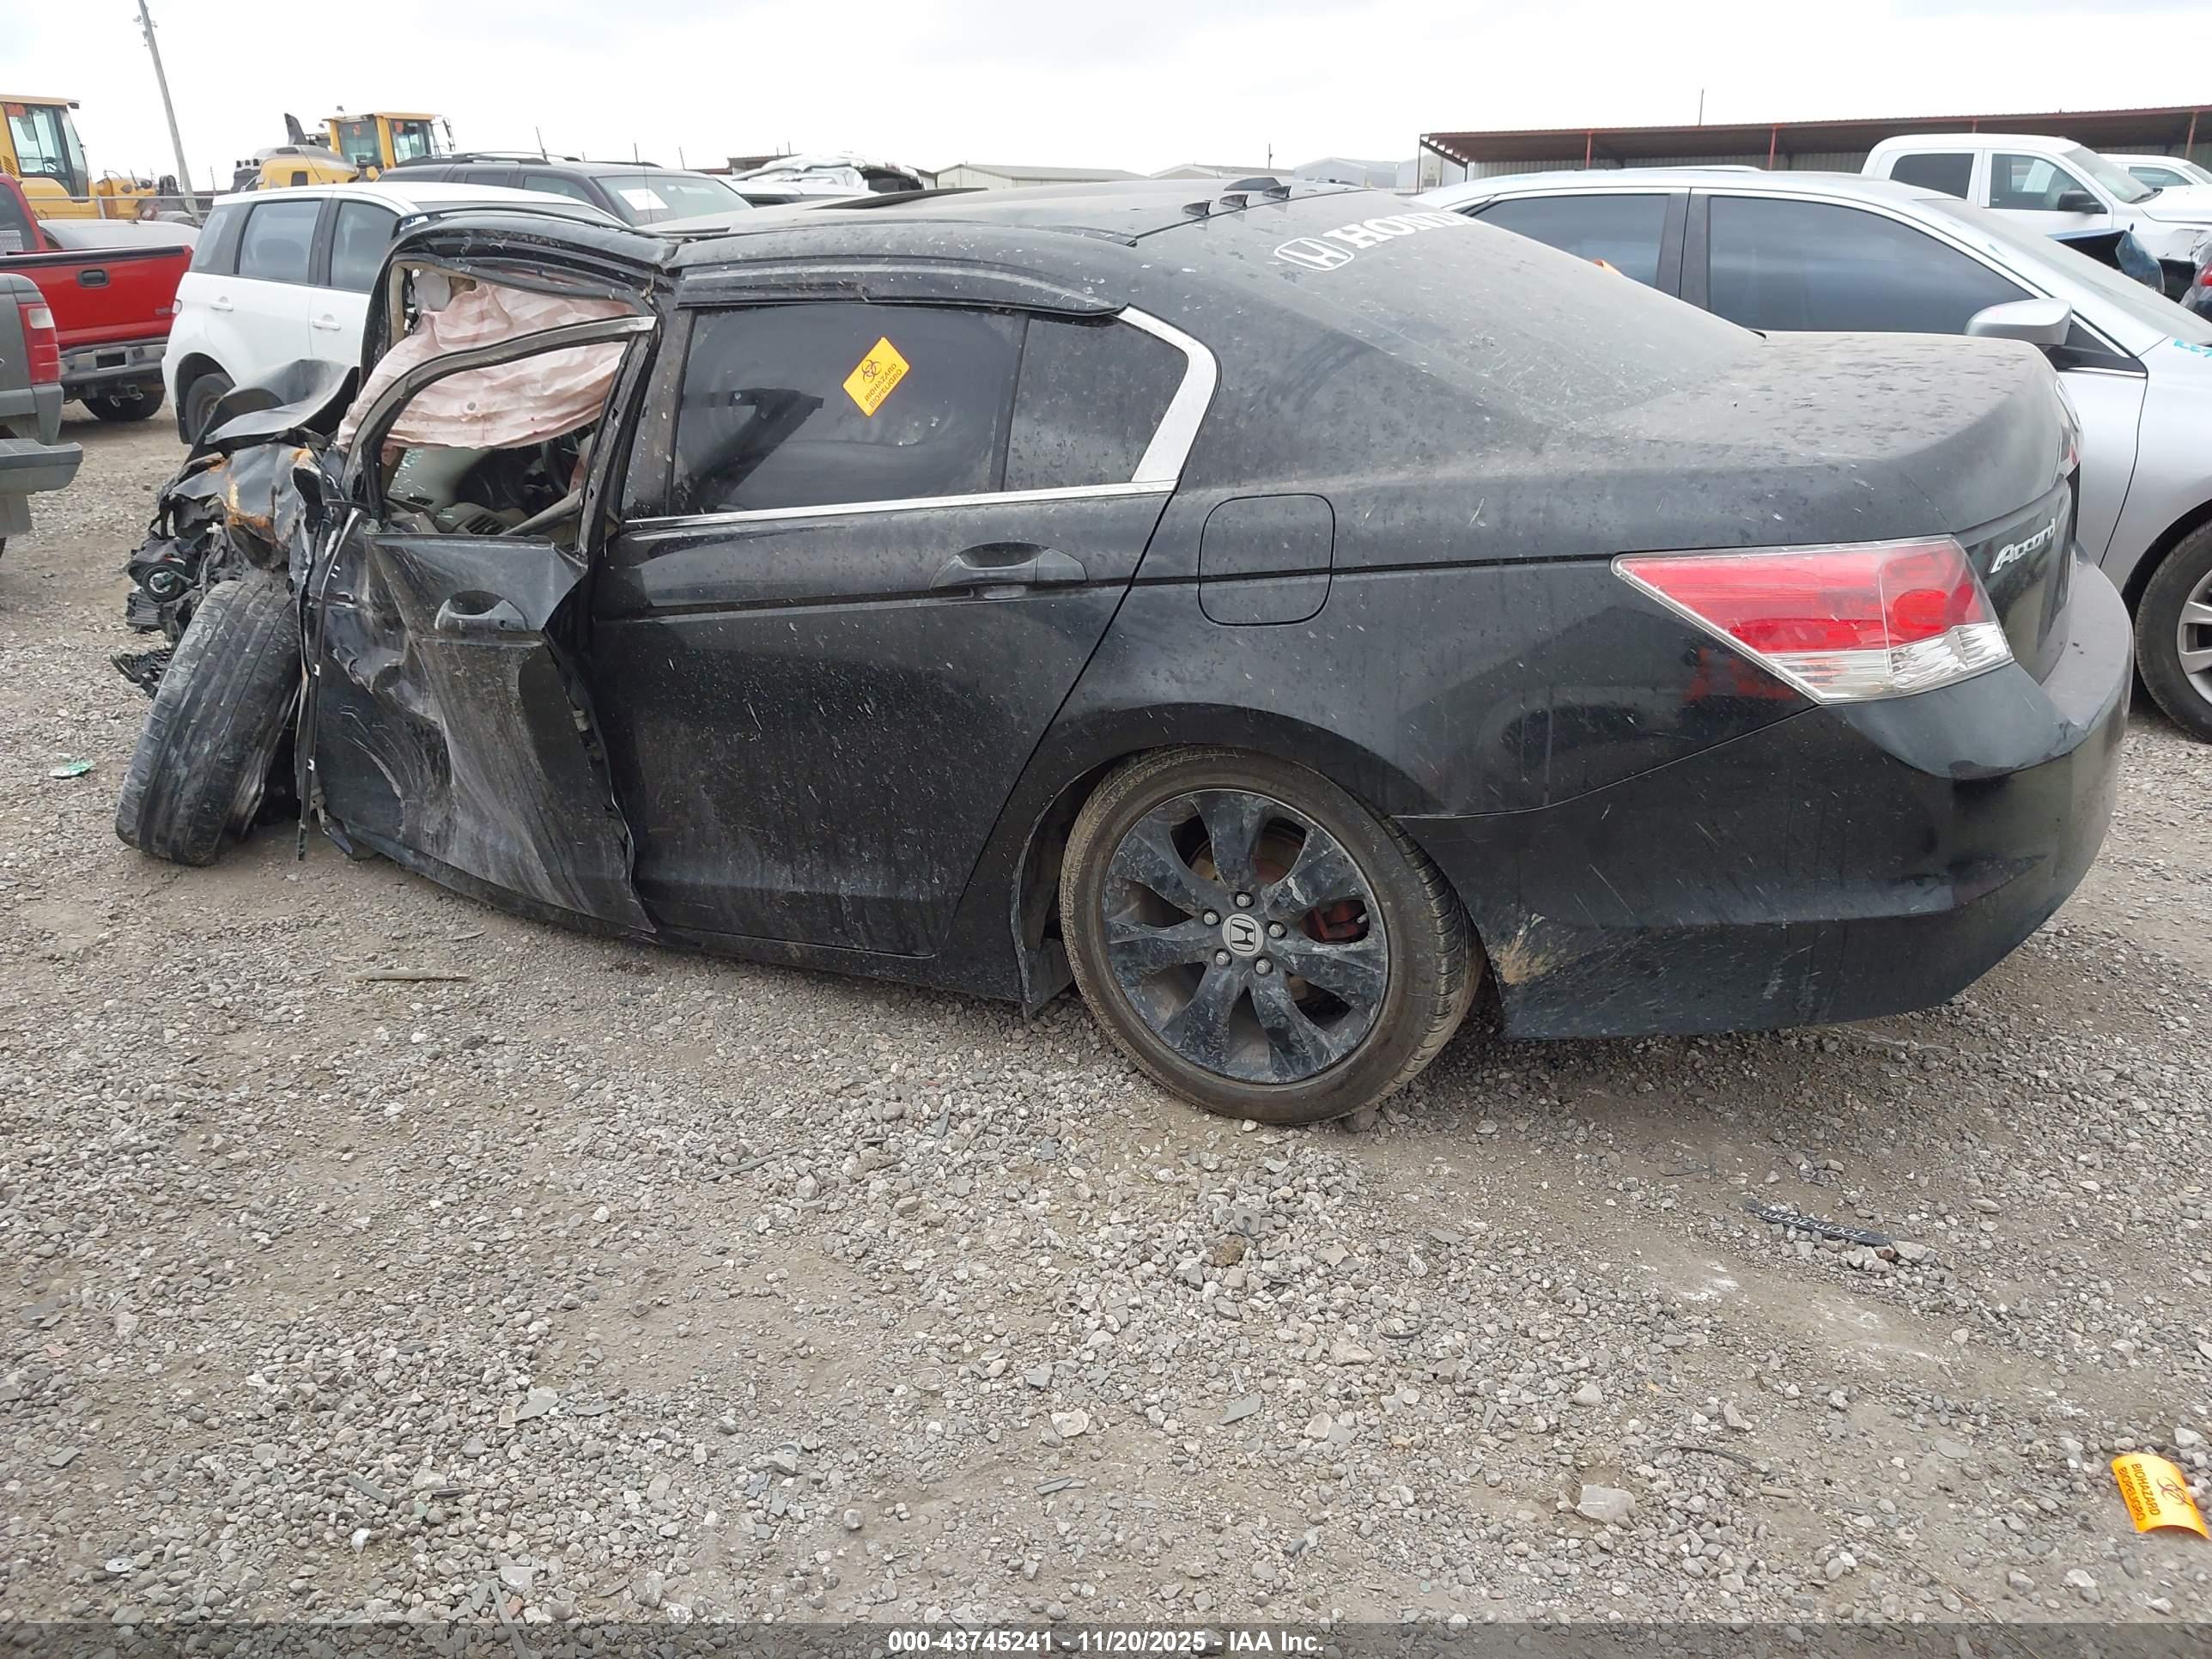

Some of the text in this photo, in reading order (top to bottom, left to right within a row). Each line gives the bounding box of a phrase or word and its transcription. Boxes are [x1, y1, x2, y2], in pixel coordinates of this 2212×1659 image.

[864, 362, 897, 402] BIOHAZARD
[1989, 517, 2056, 574] Accord
[2118, 1466, 2146, 1522] BIOPELIGRO
[2131, 1462, 2161, 1516] BIOHAZARD
